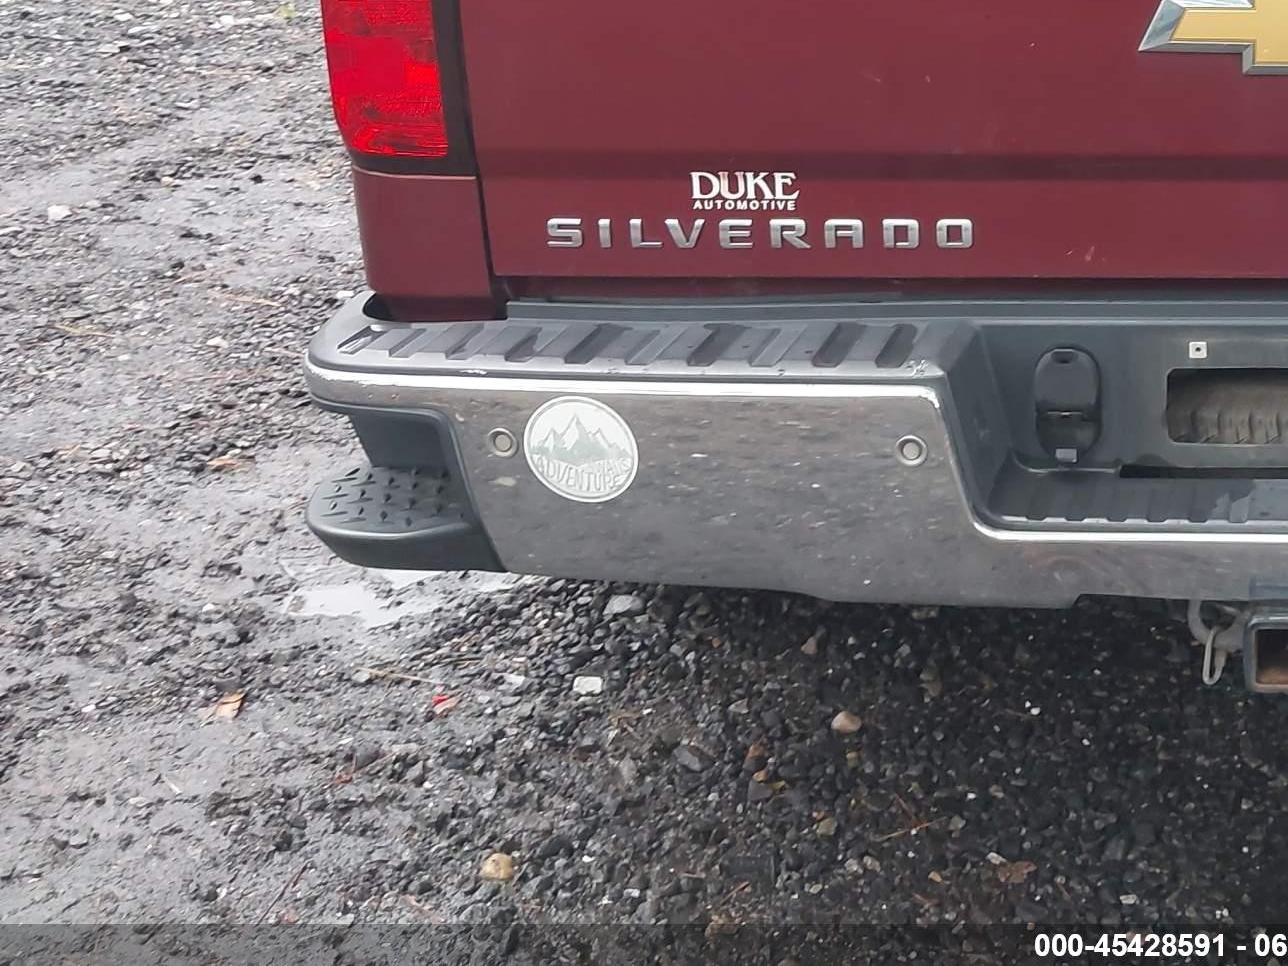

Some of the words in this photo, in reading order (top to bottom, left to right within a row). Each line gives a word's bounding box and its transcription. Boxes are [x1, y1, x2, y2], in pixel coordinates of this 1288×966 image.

[689, 171, 800, 200] DUKE
[692, 199, 797, 211] AUTOMOTIVE
[546, 218, 975, 249] SILVERADO
